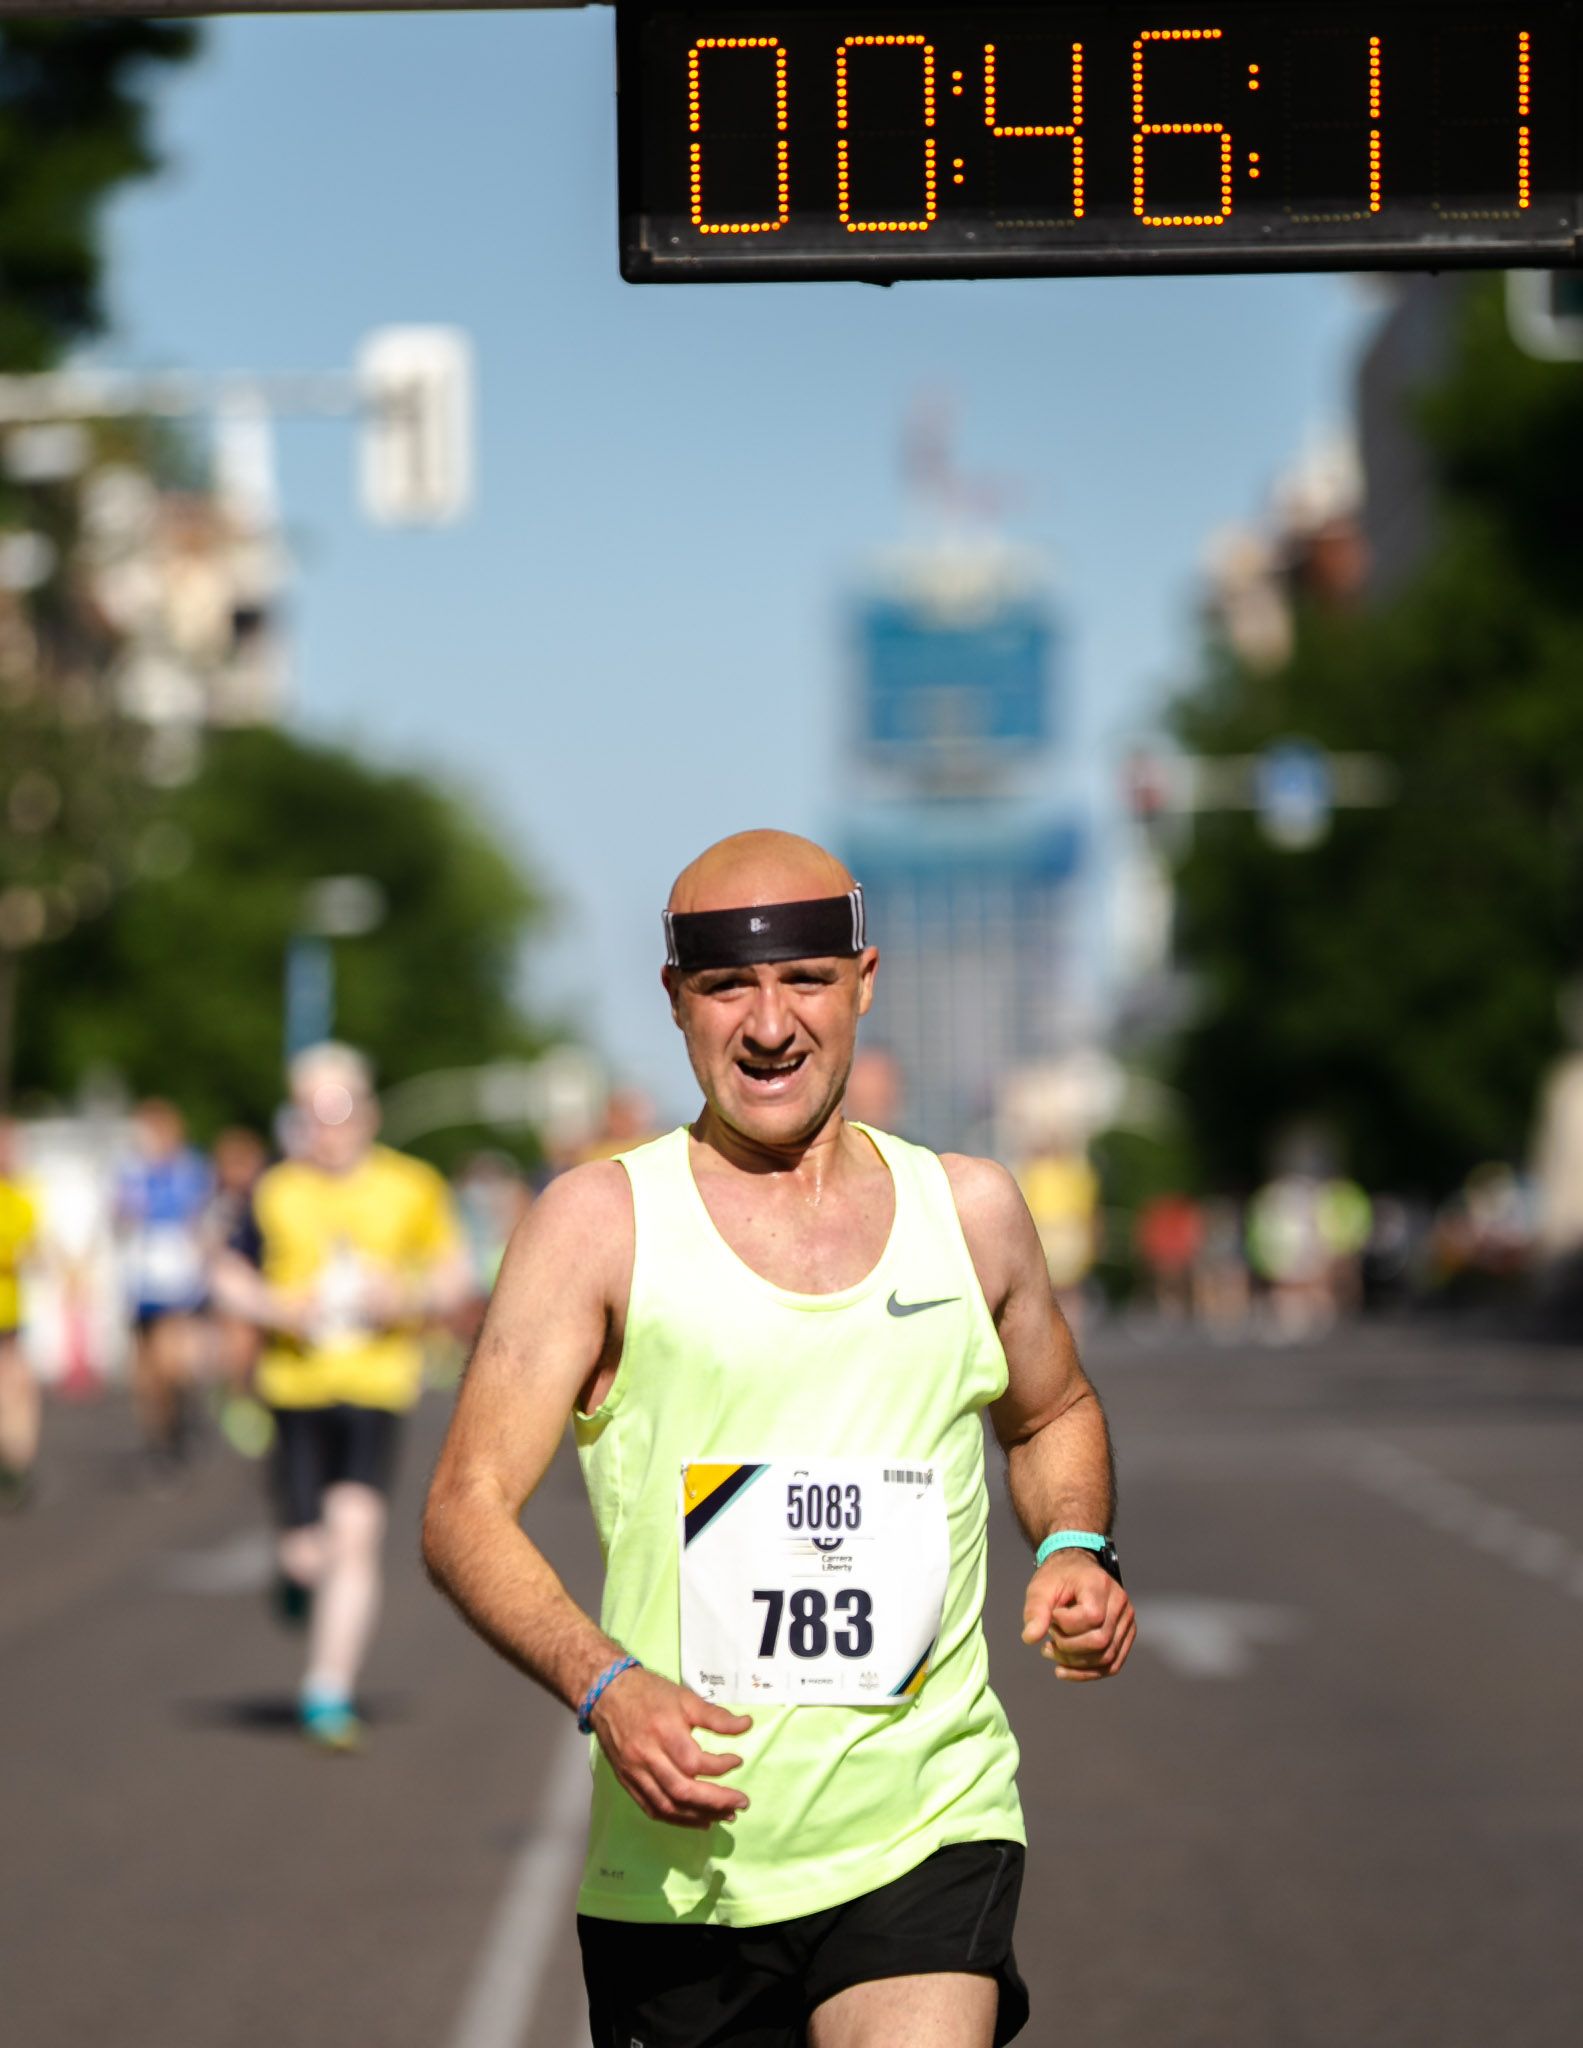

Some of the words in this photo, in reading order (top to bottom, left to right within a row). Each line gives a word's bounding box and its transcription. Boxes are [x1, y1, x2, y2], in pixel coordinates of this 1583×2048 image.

[687, 28, 1532, 236] 00:46:11
[787, 1484, 862, 1530] 5083
[752, 1588, 873, 1660] 783
